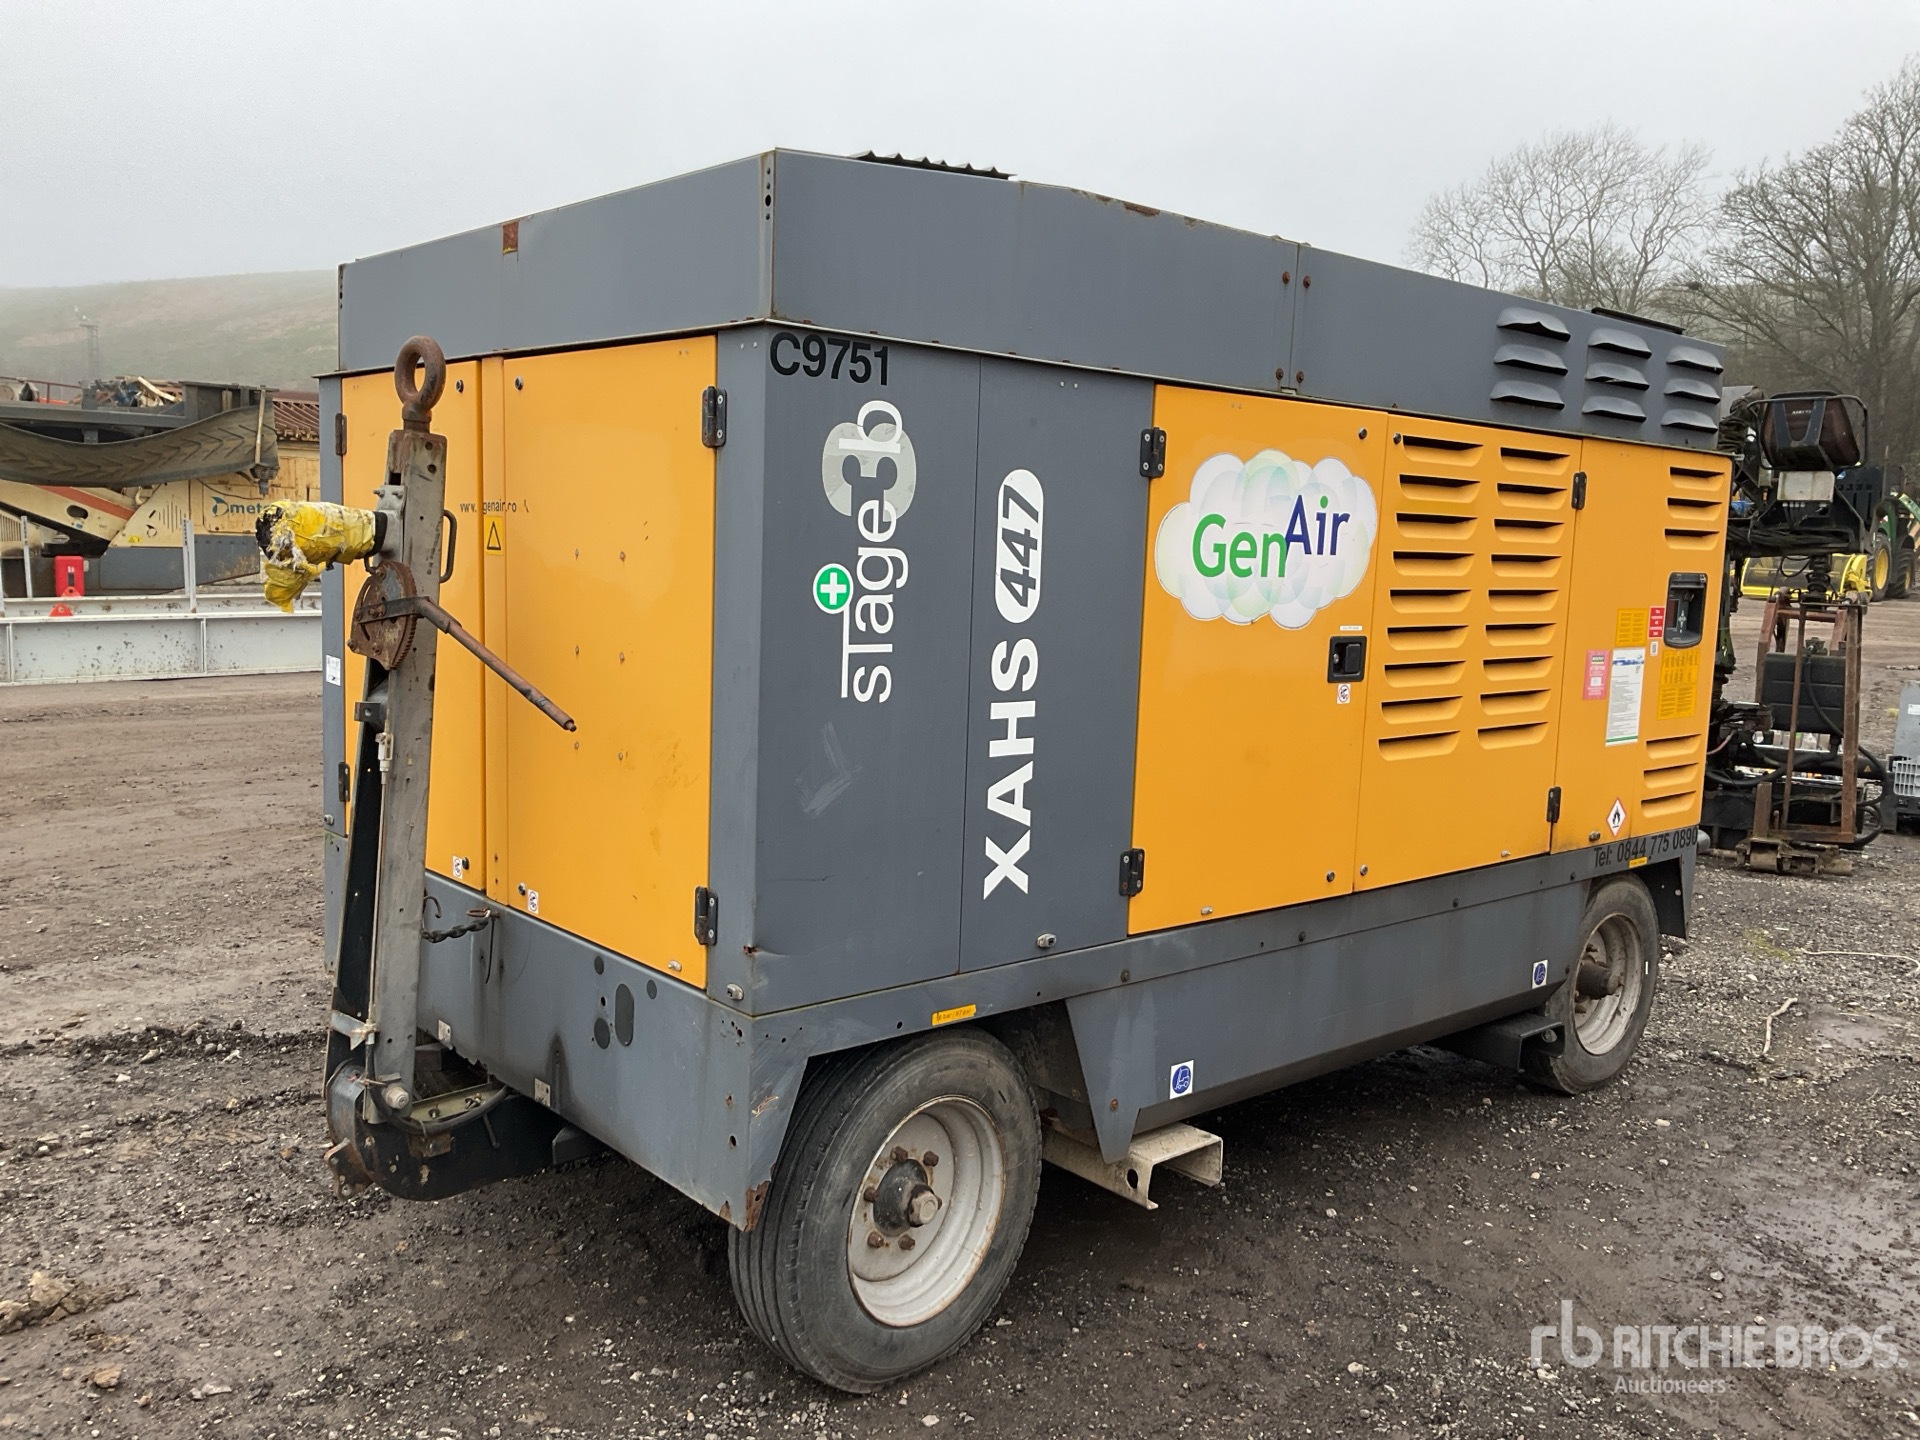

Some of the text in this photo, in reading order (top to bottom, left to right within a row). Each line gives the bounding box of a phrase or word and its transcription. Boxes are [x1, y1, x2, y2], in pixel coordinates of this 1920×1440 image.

[770, 332, 889, 386] C9751
[1192, 495, 1350, 578] GenAir
[984, 484, 1040, 900] XAHS 447
[1594, 827, 1697, 868] Tel: 0844 775 0890
